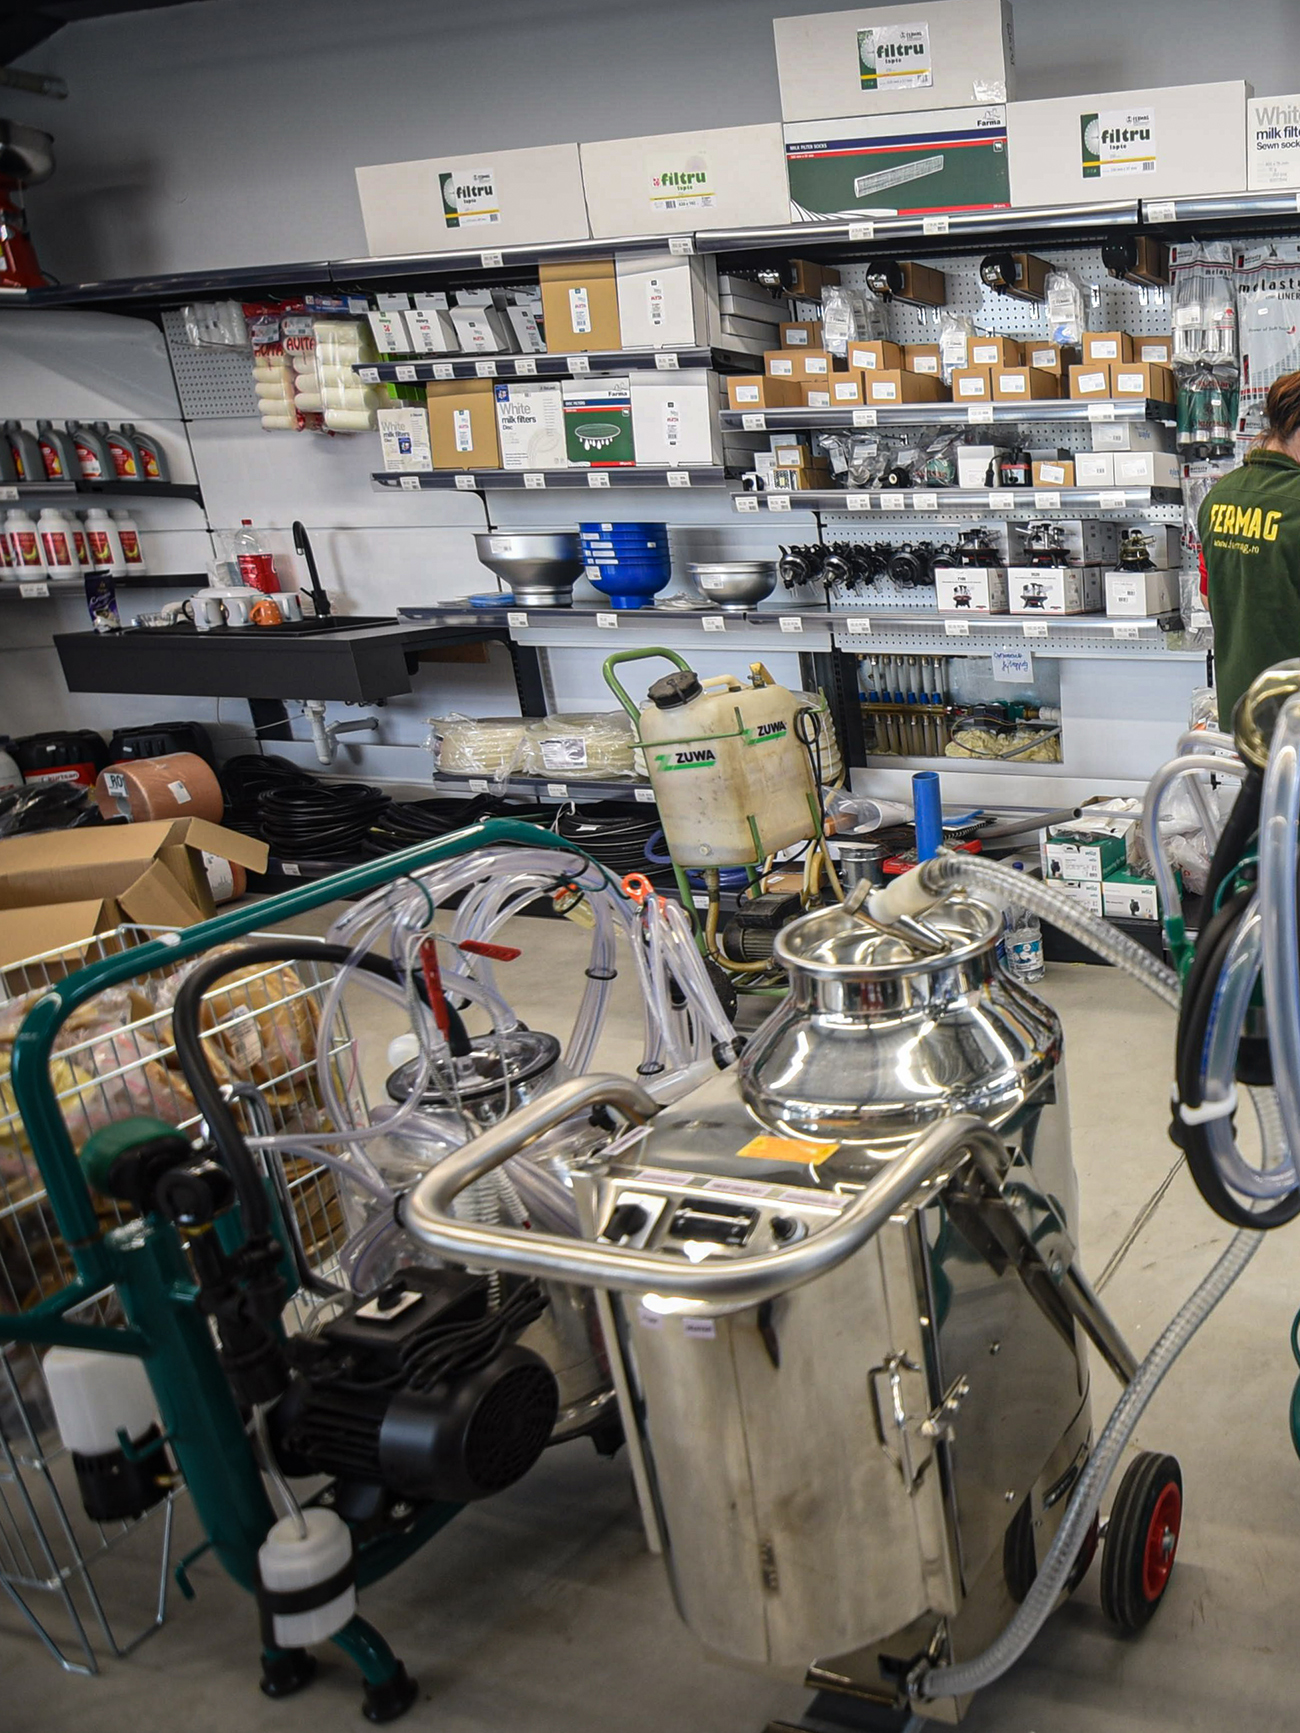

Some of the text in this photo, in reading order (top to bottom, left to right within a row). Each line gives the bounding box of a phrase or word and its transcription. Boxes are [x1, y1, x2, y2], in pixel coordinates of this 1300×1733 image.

[876, 42, 925, 59] filtru
[977, 118, 1001, 127] Farma
[1101, 127, 1151, 145] filtru
[1256, 126, 1282, 142] milk
[1256, 139, 1300, 151] Sewn sock
[661, 171, 707, 186] filtru
[456, 184, 494, 200] filtru
[286, 336, 316, 351] AVITA
[500, 403, 531, 415] White
[381, 421, 406, 432] White
[502, 415, 537, 424] milk filters
[1210, 504, 1283, 542] FERMAG
[757, 721, 787, 737] ZUWA
[675, 750, 716, 764] ZUWA
